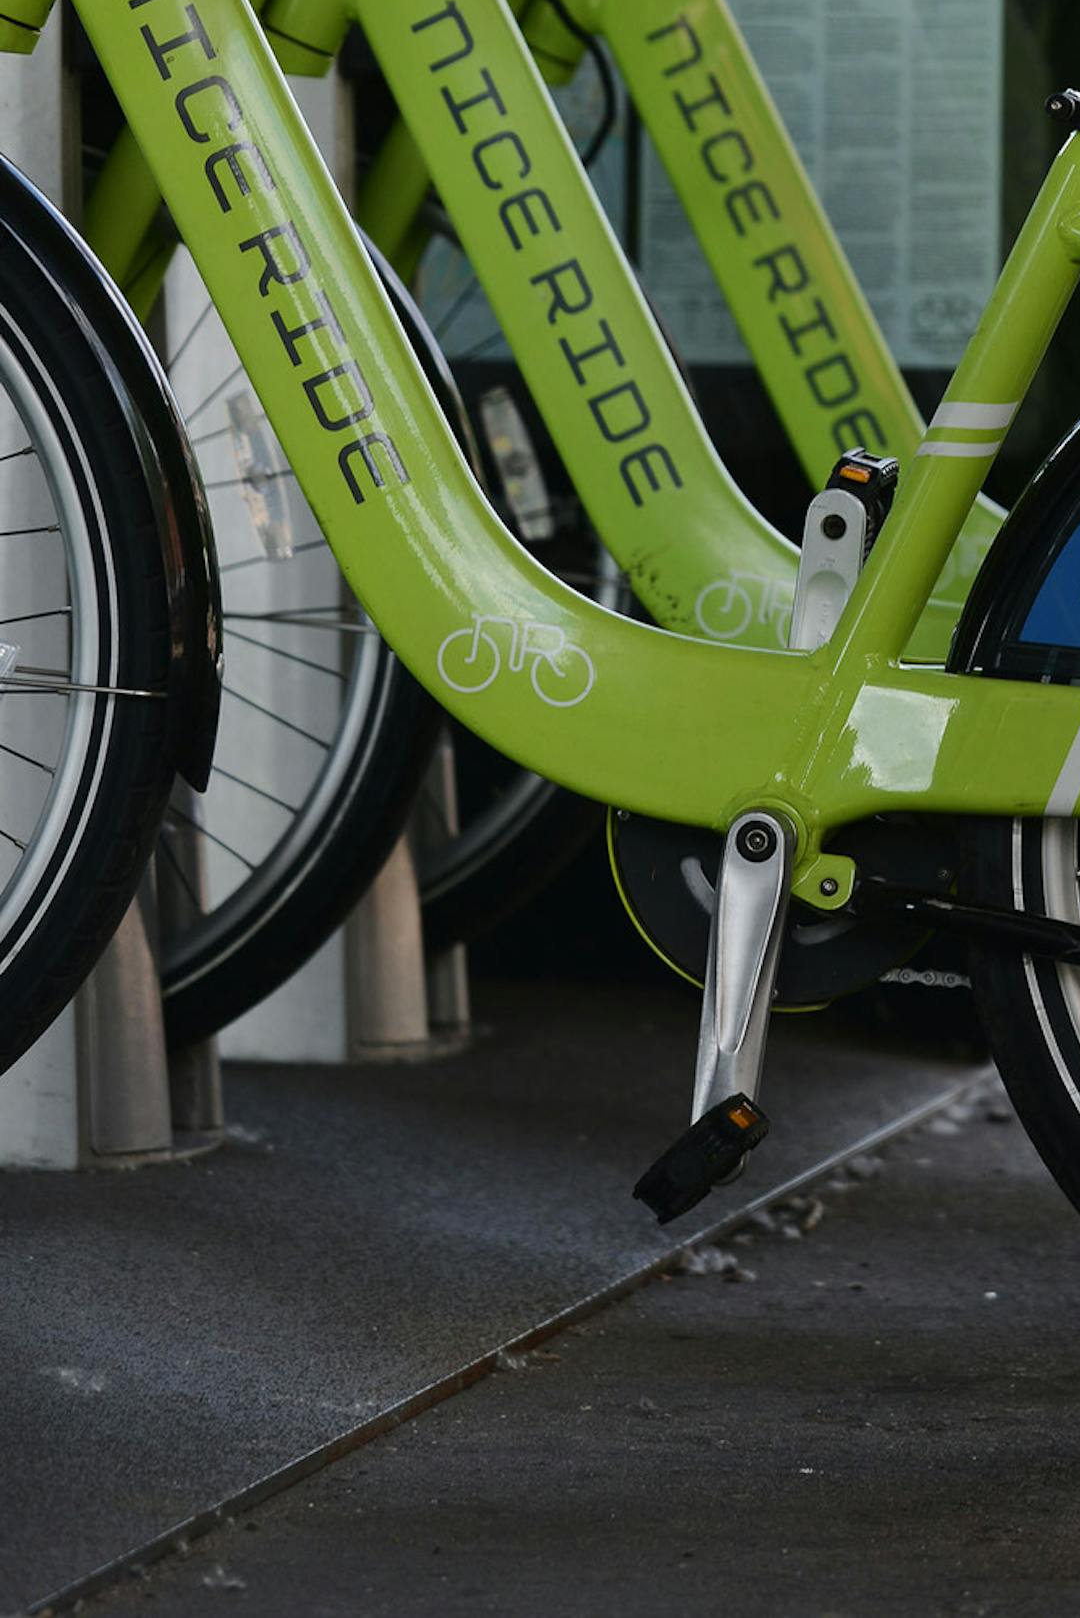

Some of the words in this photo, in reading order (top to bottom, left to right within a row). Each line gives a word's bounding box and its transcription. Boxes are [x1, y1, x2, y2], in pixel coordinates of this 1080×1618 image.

[239, 218, 411, 506] RIDE
[530, 258, 683, 508] RIDE
[753, 243, 888, 454] RIDE
